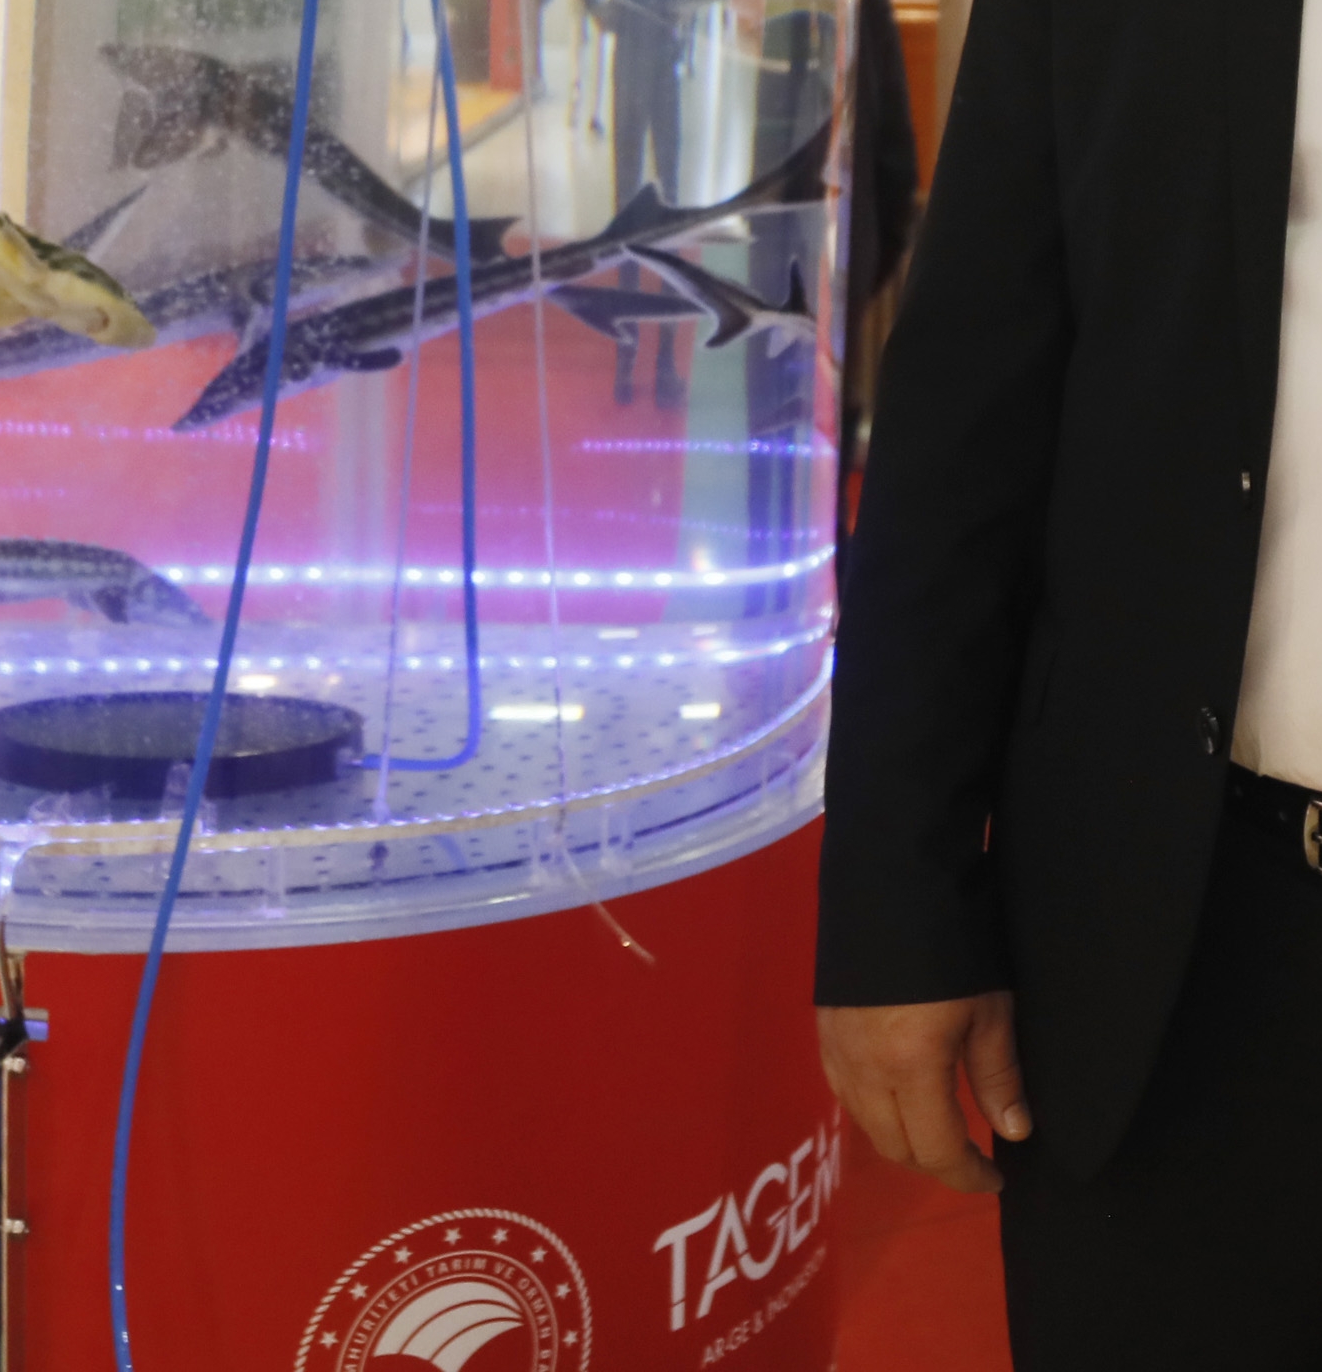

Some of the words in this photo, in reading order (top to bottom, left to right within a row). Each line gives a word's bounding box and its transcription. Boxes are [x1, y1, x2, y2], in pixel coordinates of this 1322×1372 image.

[426, 1257, 488, 1279] TARIM
[494, 1260, 516, 1280] VE
[653, 1102, 841, 1332] TAGEM
